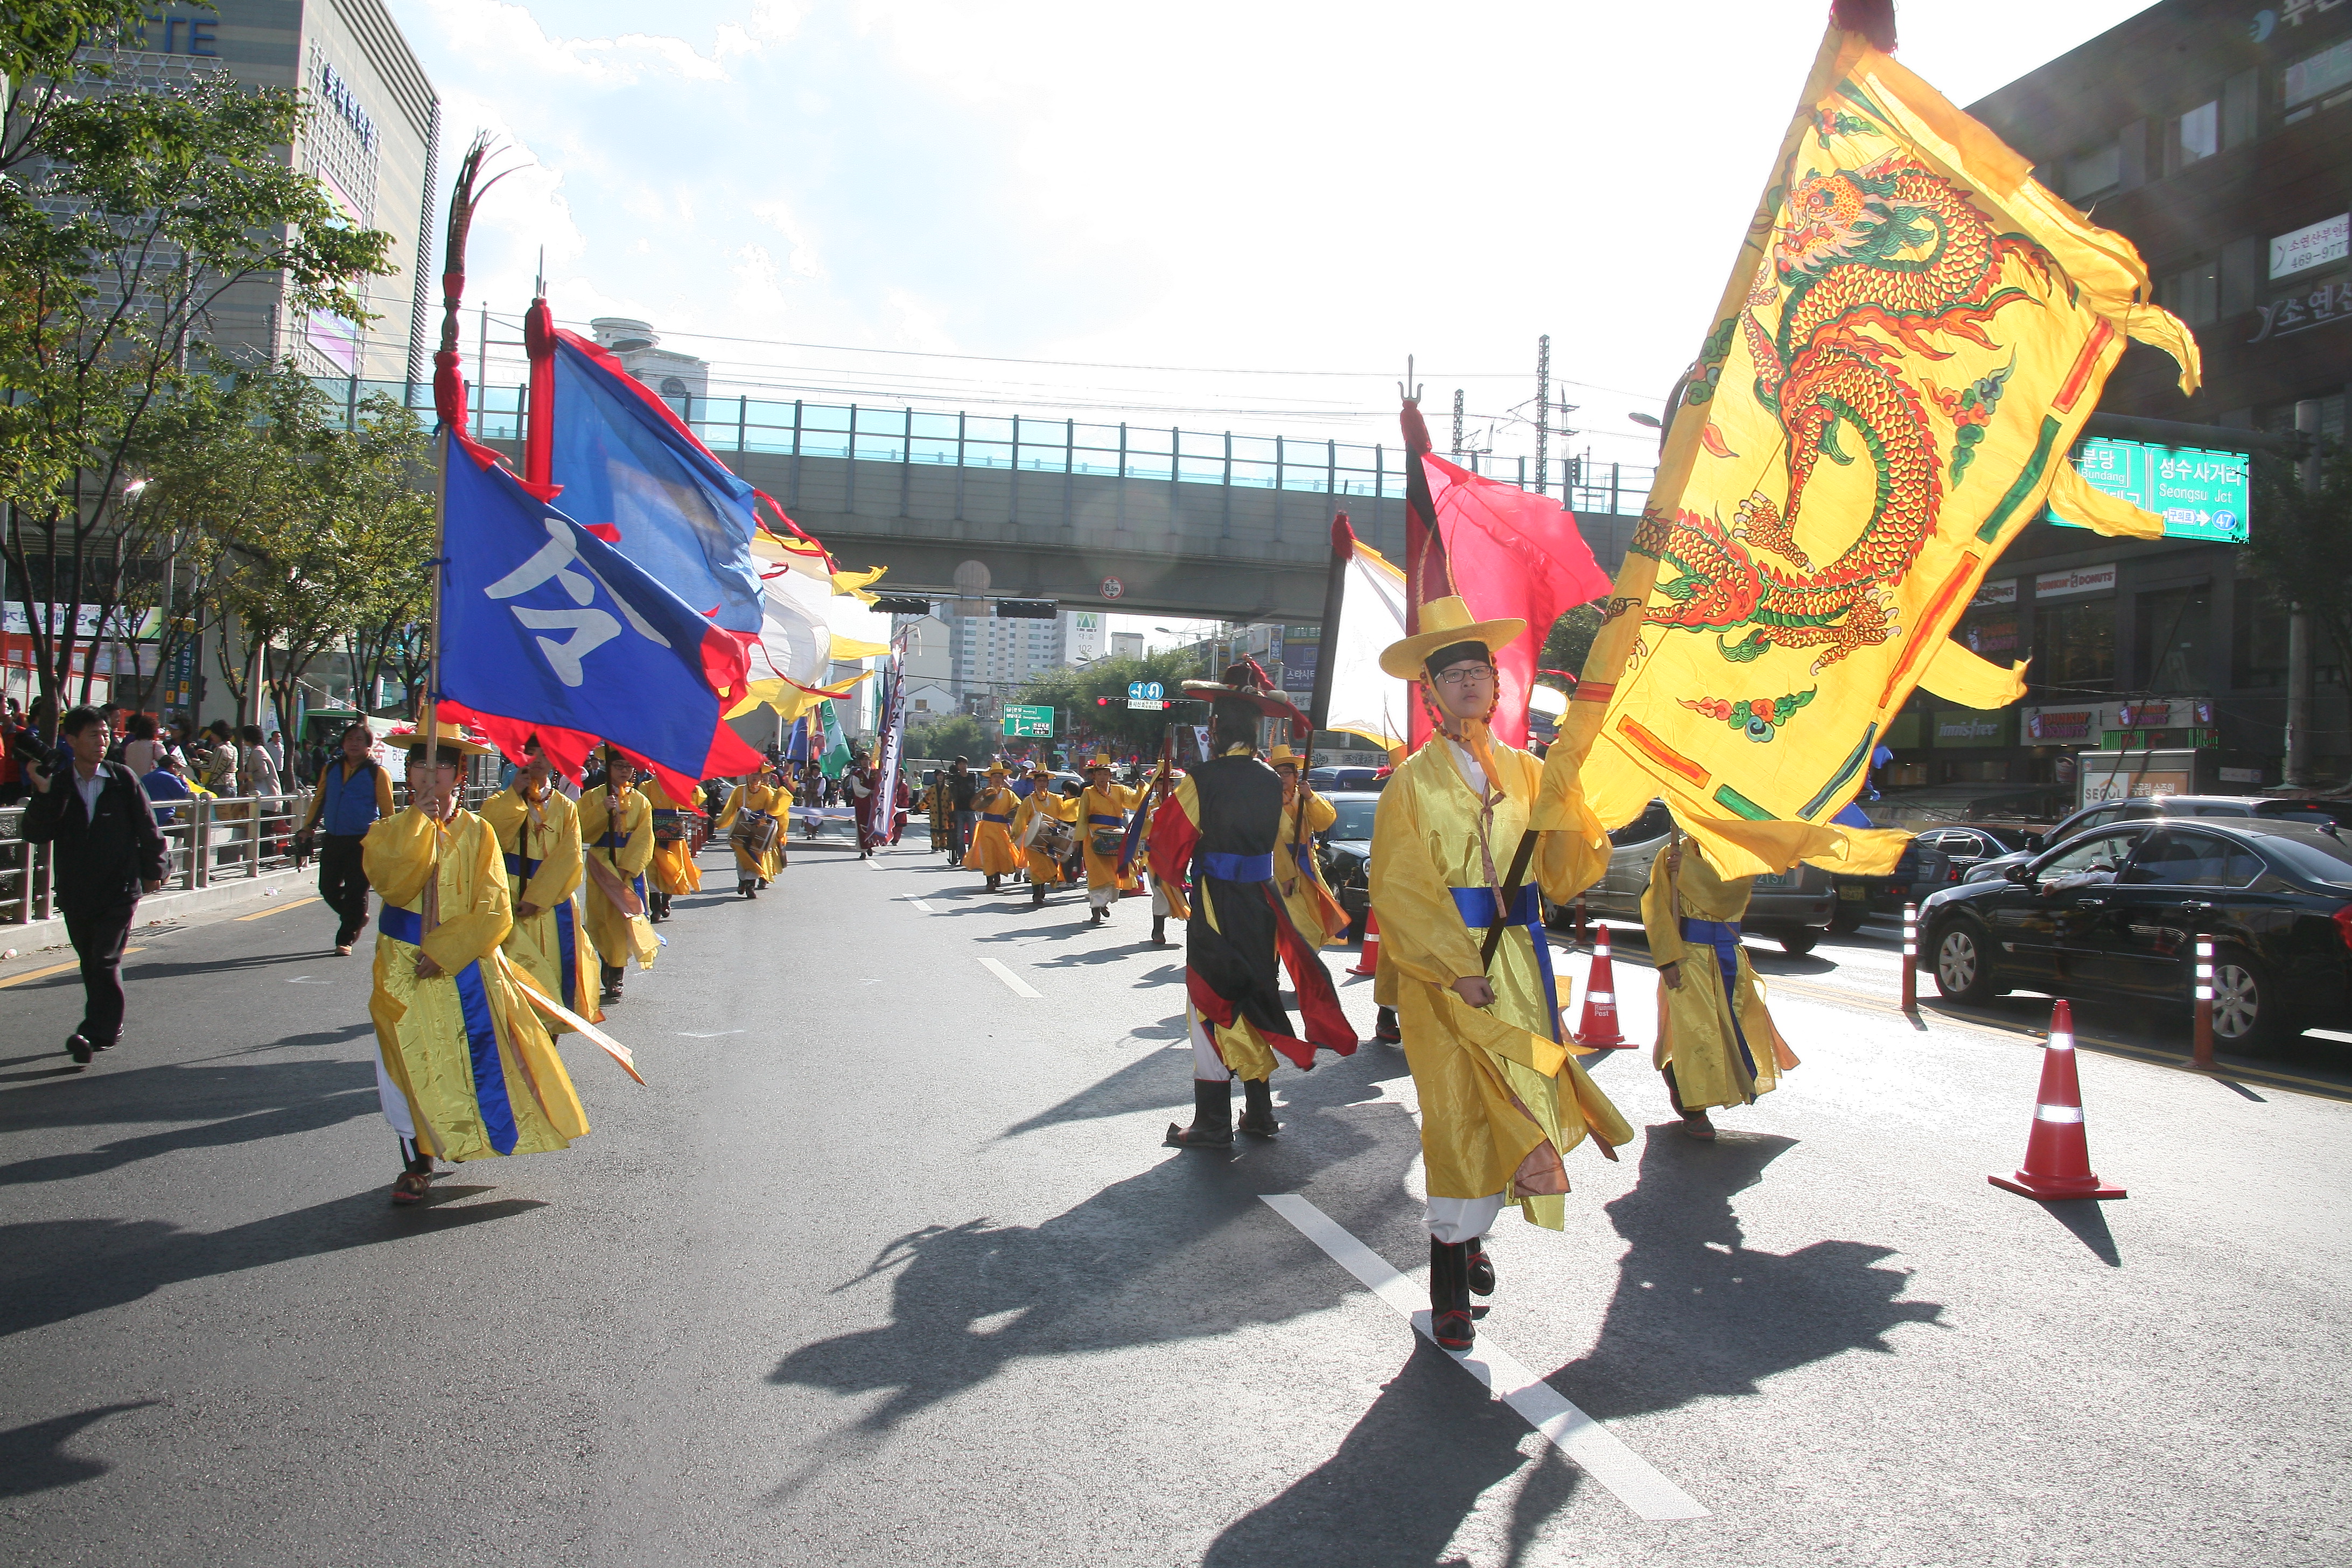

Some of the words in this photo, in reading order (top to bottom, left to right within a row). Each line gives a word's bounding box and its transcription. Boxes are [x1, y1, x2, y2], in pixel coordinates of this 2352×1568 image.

[2291, 240, 2350, 268] 469-9777
[2083, 447, 2115, 470] 분당
[2081, 469, 2125, 485] Bundang
[2159, 458, 2243, 486] 성수사거리
[2158, 483, 2208, 503] Seongsu
[2214, 489, 2232, 503] Jct
[2169, 510, 2193, 522] 구의로
[2217, 514, 2232, 528] 47
[1105, 583, 1119, 592] 8.5m
[1078, 644, 1092, 652] 102
[1938, 718, 1998, 740] innisfree
[2085, 787, 2123, 800] SEOUL
